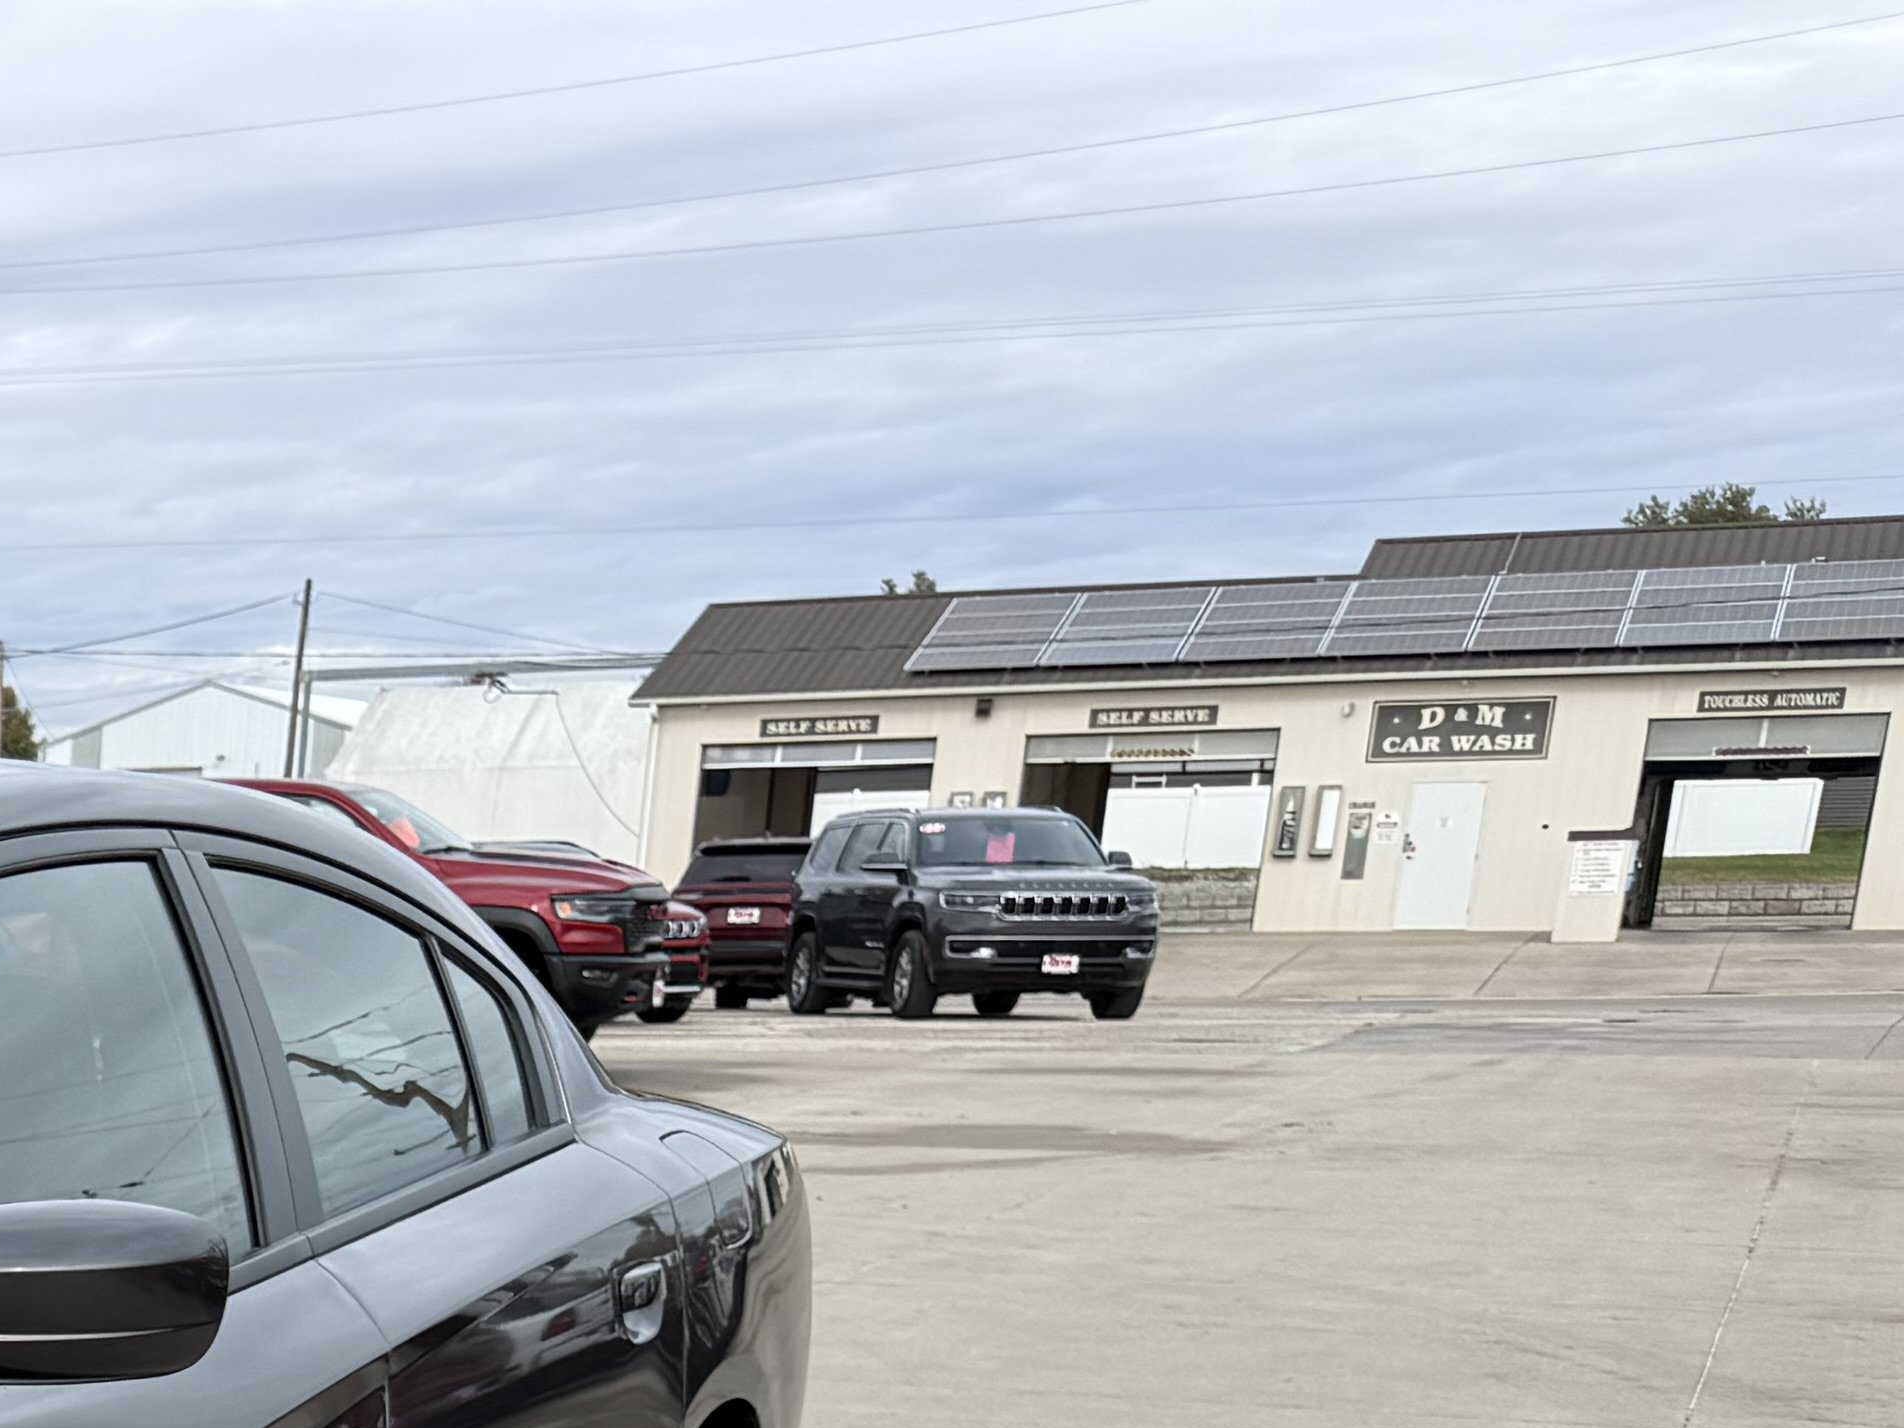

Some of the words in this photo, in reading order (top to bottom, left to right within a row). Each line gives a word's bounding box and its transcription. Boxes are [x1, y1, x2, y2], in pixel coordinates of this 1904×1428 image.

[1703, 693, 1769, 709] TOUCHLESS
[1773, 691, 1841, 707] AUTOMATIC
[1096, 710, 1145, 725] SELF
[1148, 708, 1210, 724] SERVE
[1418, 706, 1446, 730] D
[1454, 706, 1468, 722] &
[1475, 704, 1506, 728] M
[765, 720, 812, 735] SELF
[813, 717, 872, 734] SERVE
[1382, 736, 1441, 754] CAR
[1450, 733, 1537, 752] WASH
